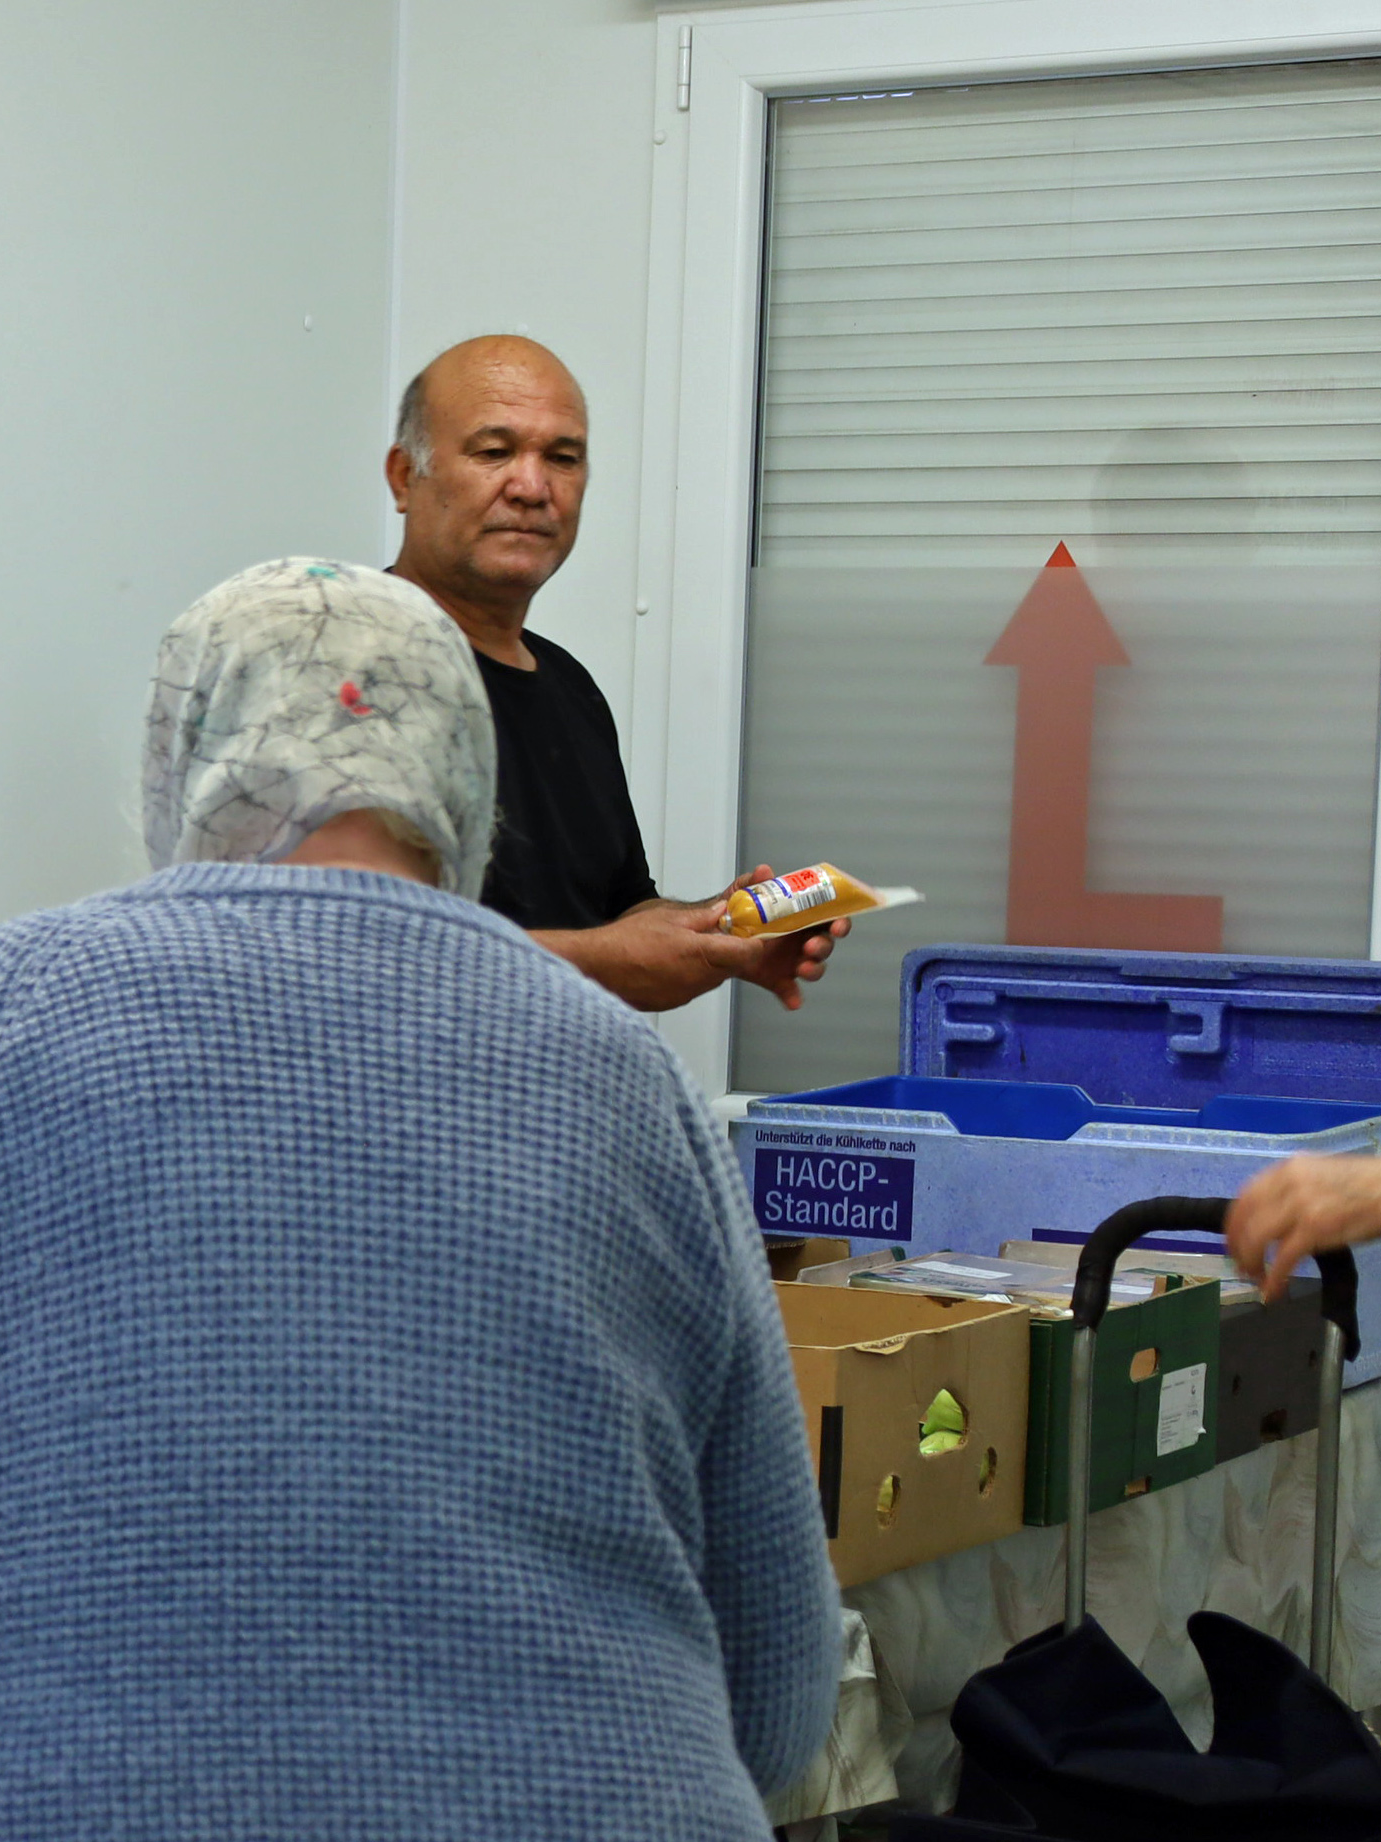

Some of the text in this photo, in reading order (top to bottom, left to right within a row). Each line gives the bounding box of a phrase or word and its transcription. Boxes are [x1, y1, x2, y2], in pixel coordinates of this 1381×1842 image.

[755, 1129, 916, 1153] Unterstützt die Kühlkette nach
[776, 1155, 889, 1192] HACCP-
[764, 1190, 898, 1231] Standard
